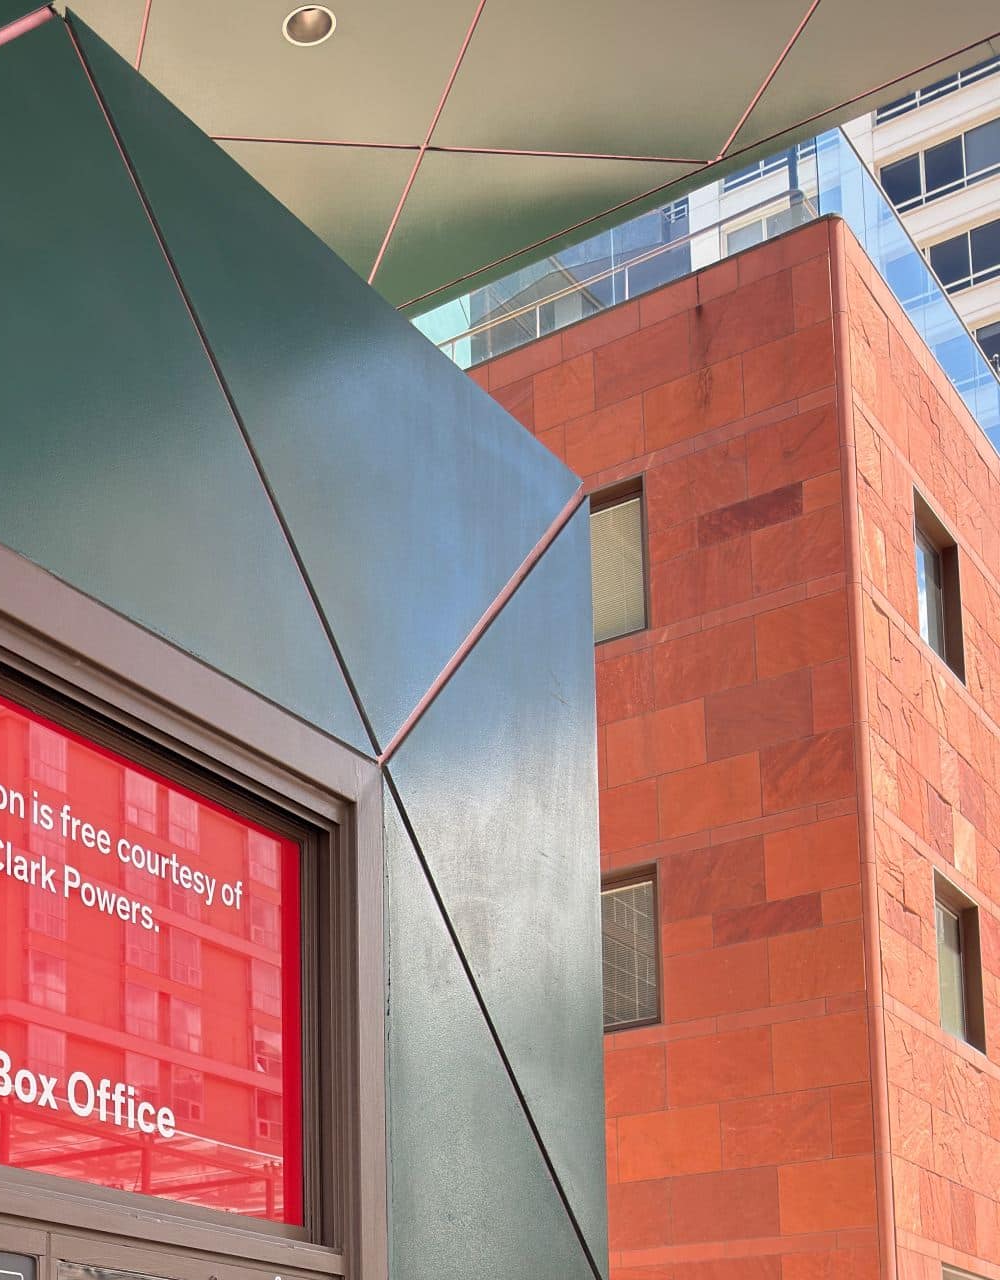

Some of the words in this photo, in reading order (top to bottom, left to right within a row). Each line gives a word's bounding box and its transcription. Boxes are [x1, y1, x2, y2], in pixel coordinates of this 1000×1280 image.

[32, 791, 54, 829] is
[60, 804, 111, 854] free
[117, 840, 216, 904] courtesy
[221, 881, 243, 911] of
[64, 864, 161, 933] Powers.
[66, 1070, 177, 1138] Office
